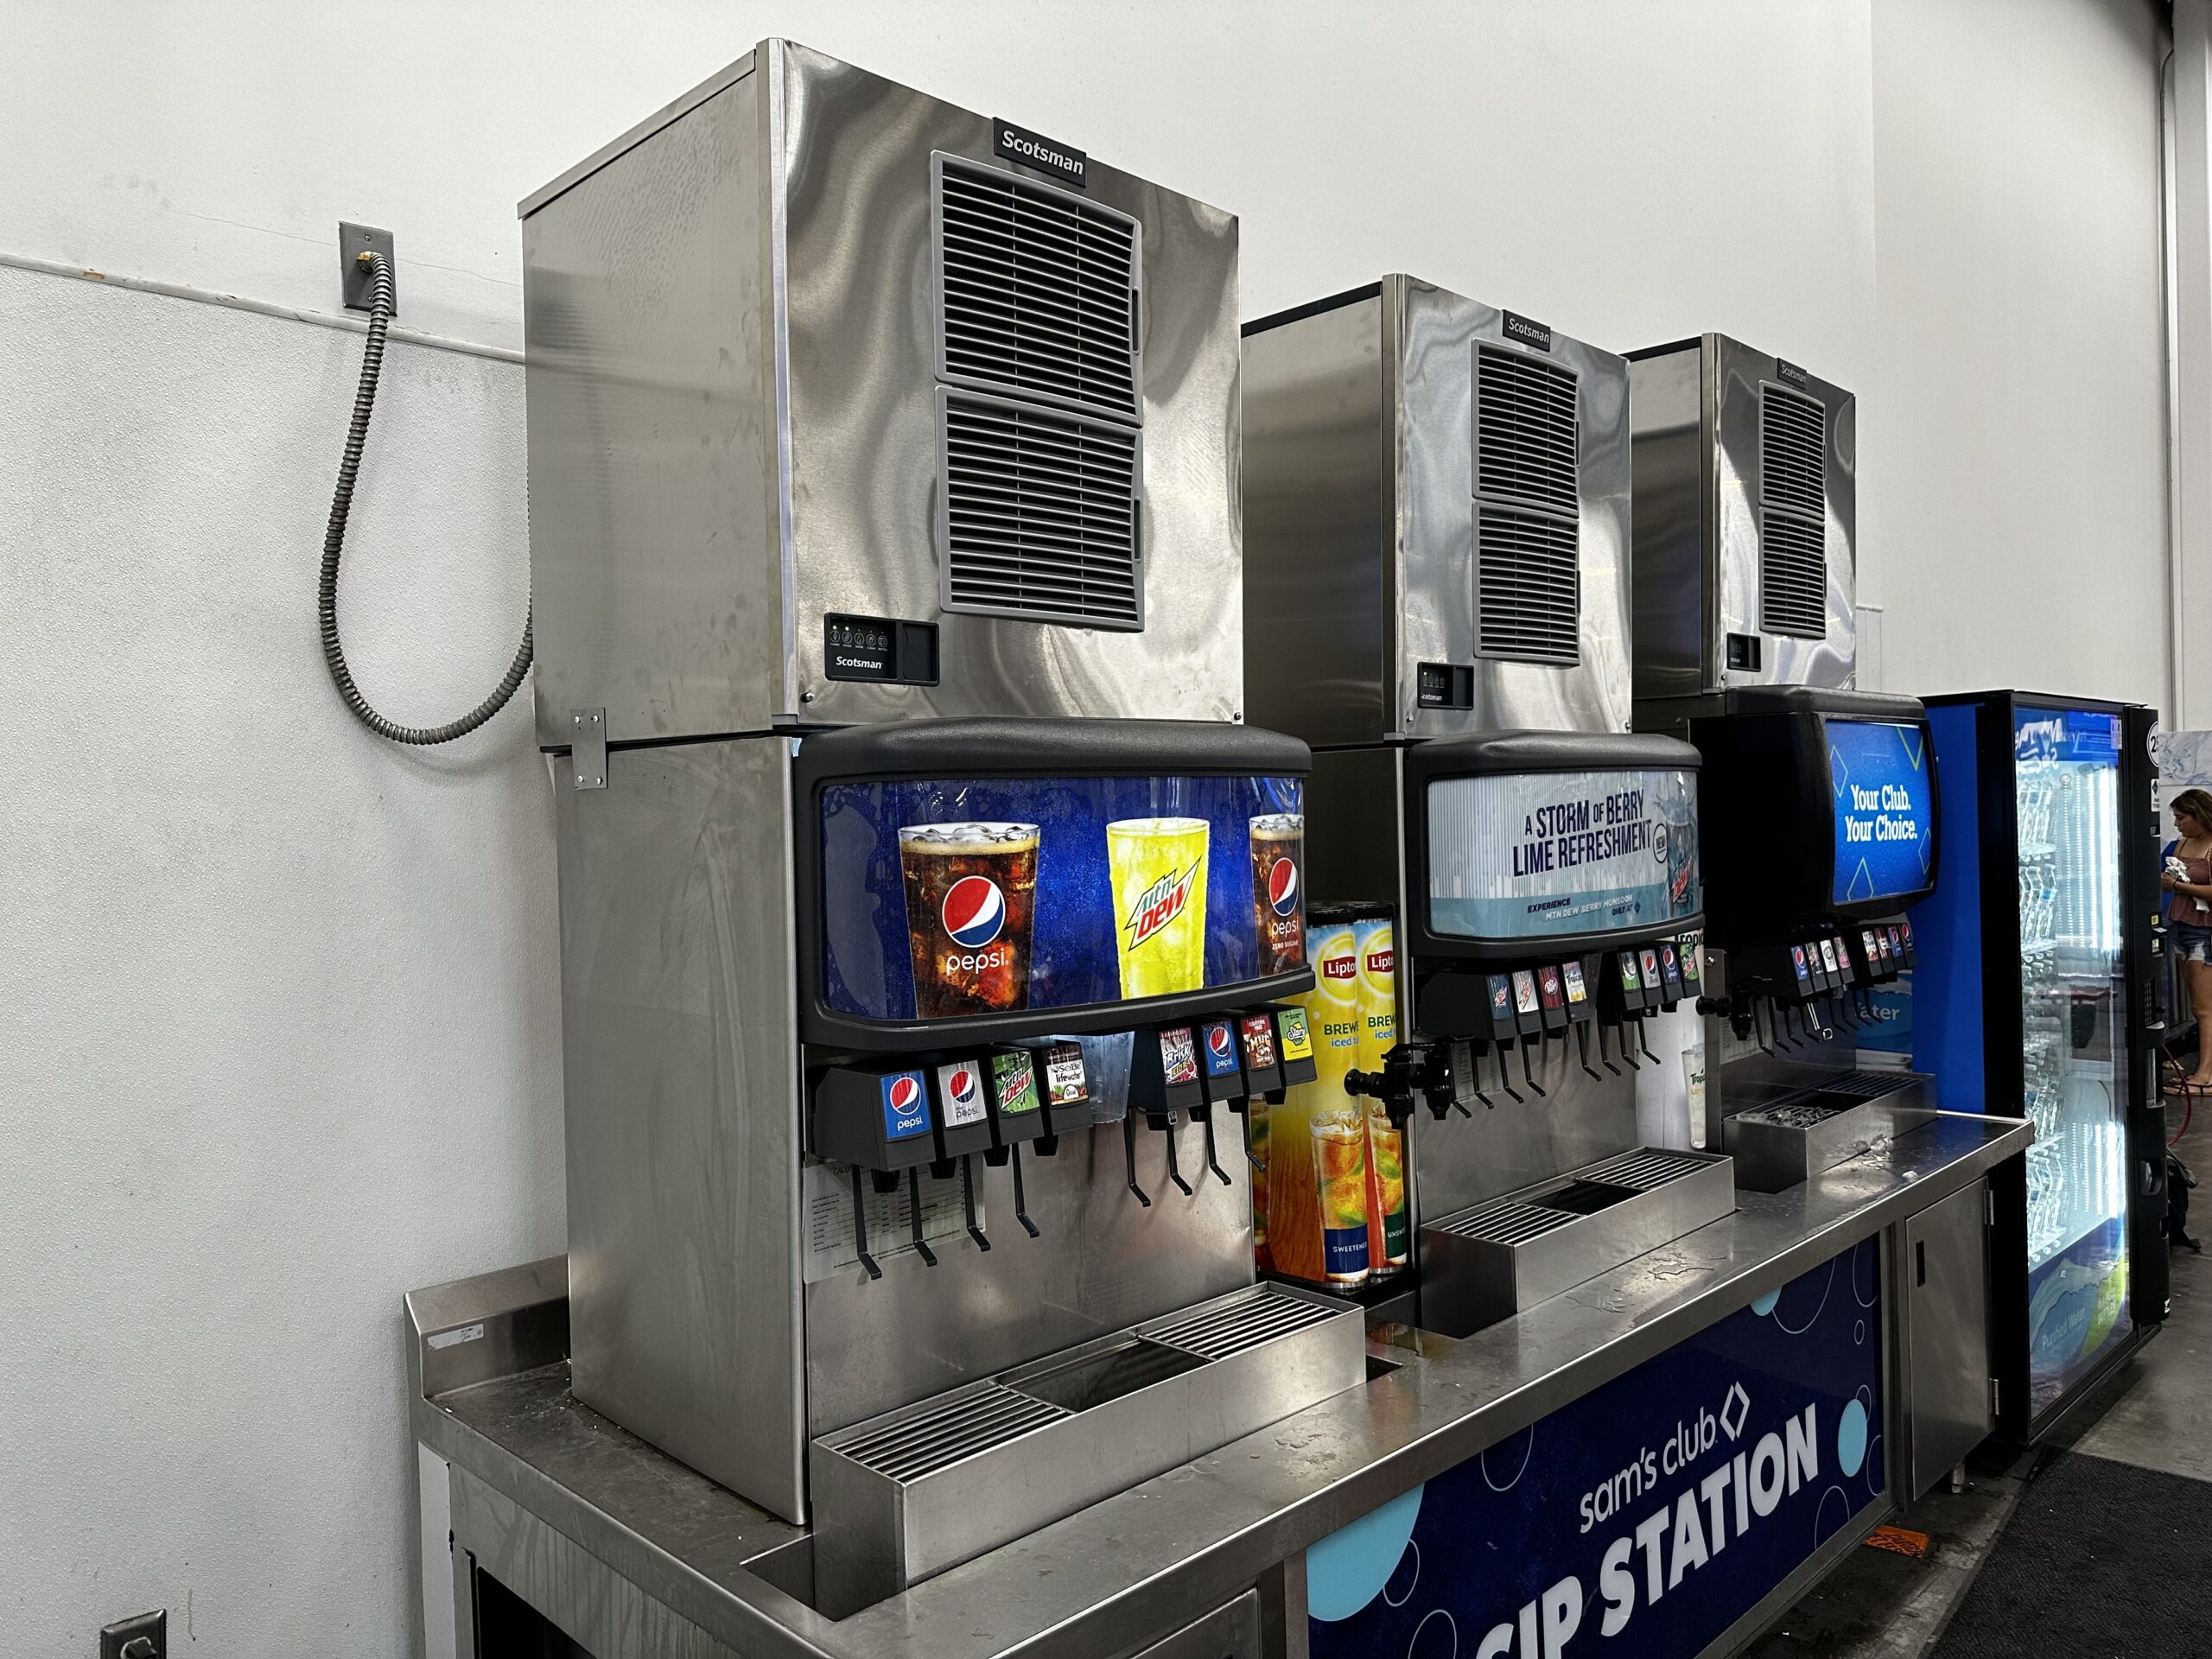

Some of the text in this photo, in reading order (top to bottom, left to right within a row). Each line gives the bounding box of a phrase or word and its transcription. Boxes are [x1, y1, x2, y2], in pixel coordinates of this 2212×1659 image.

[1001, 130, 1084, 175] Scotsman
[1508, 317, 1550, 344] Scotsman
[836, 656, 882, 670] Scotsman
[1850, 784, 1911, 811] Your Club.
[1524, 789, 1645, 839] A STORM OF BERRY
[1845, 813, 1918, 842] Your Choice.
[1513, 818, 1652, 877] LIME REFRESHMENT
[1527, 897, 1571, 913] EXPERIENCE
[1545, 893, 1633, 922] MTN DEW BERRY MONSOON
[1271, 915, 1300, 940] pepsi
[1272, 939, 1300, 950] ZERO SUGAR
[946, 947, 1005, 976] pepsi
[1327, 961, 1357, 977] Lipto
[1324, 1020, 1359, 1036] BREWE
[1375, 1029, 1392, 1039] iced
[1331, 1036, 1352, 1047] iced
[1215, 1057, 1234, 1070] pepsi
[897, 1115, 924, 1132] pepsi
[956, 1106, 979, 1121] pepsi
[1580, 1405, 1717, 1534] sam's club
[1599, 1402, 1819, 1637] STATION
